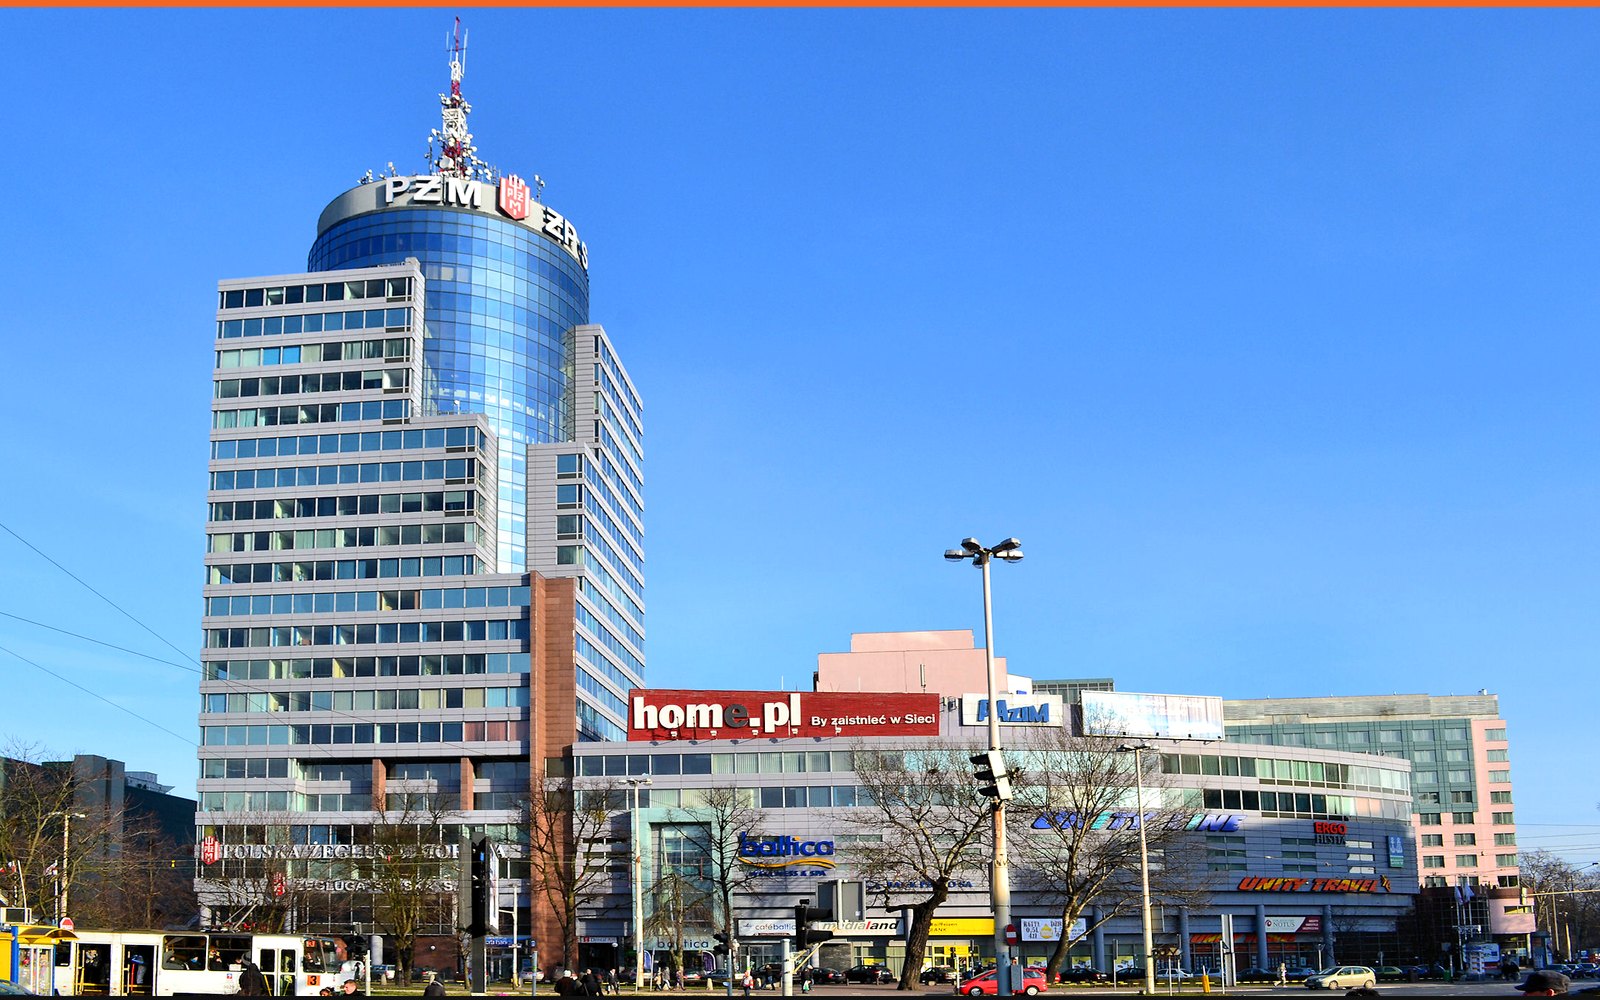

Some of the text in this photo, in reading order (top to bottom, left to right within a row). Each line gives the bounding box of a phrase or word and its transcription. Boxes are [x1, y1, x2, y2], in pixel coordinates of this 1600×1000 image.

[633, 692, 801, 734] home.pl
[977, 699, 1050, 723] PAZIM
[811, 713, 936, 727] By zaistnieć w Sieci
[1315, 821, 1348, 835] ERGO
[223, 844, 300, 859] POLSKA
[739, 831, 834, 857] baltica
[1238, 877, 1379, 892] UNITY TRAVEL
[657, 939, 709, 949] batica
[310, 975, 317, 985] 3
